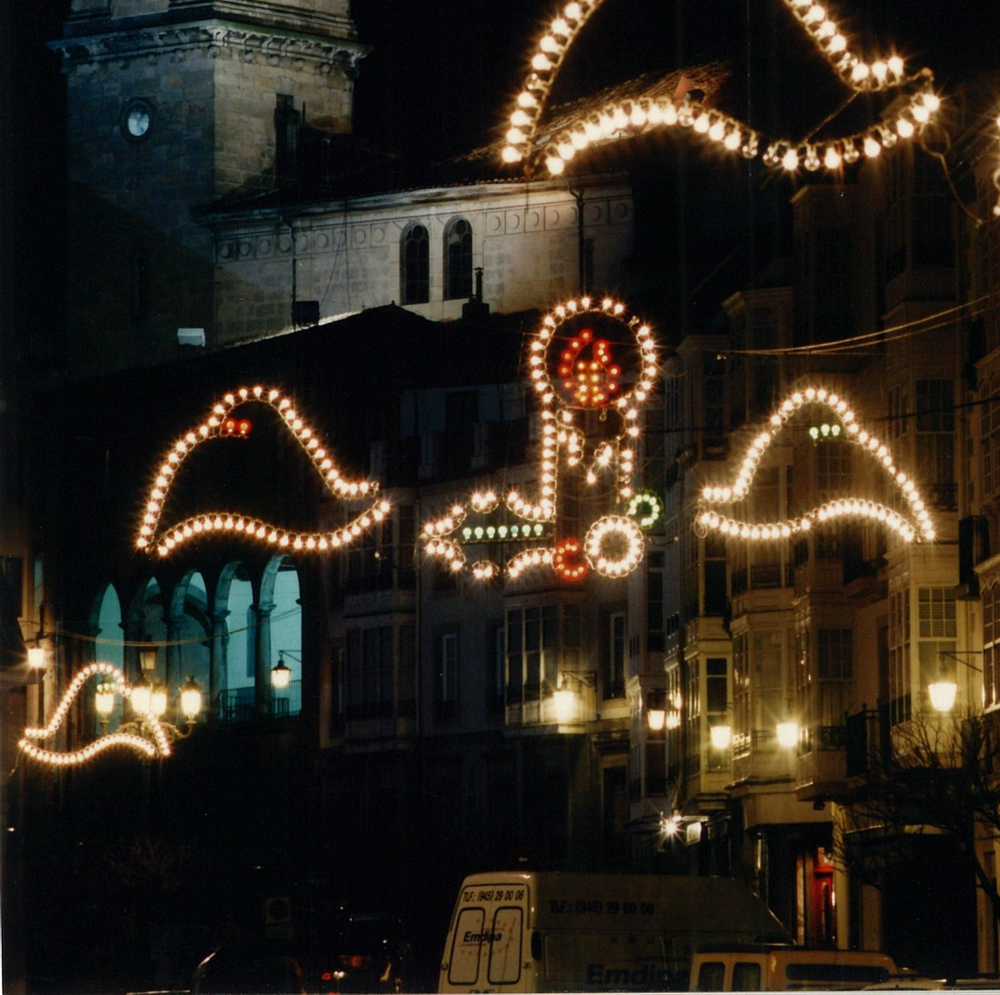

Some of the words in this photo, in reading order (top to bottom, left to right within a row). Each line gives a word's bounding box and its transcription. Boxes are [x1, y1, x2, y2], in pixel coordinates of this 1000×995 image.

[495, 890, 504, 901] 29
[505, 890, 514, 901] 00
[515, 890, 525, 900] 06
[607, 901, 619, 915] 29
[463, 931, 502, 943] Emdipa
